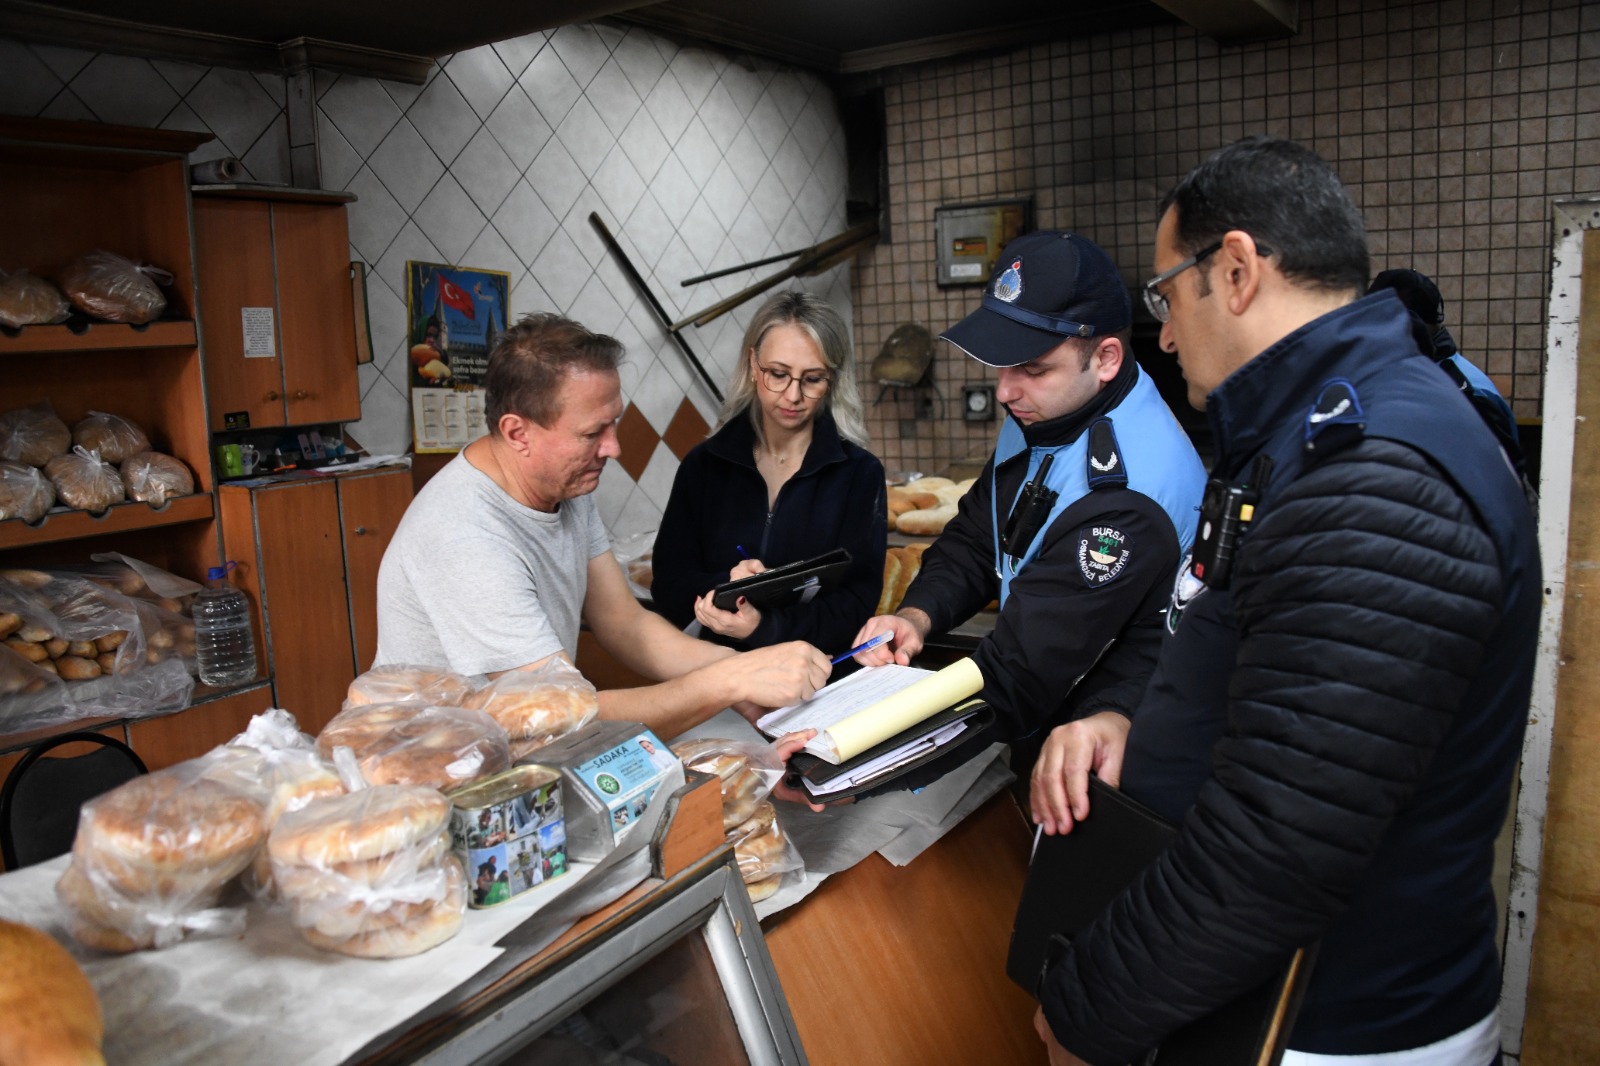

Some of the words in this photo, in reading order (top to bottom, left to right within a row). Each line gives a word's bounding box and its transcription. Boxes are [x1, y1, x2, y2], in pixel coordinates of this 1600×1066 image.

[452, 356, 475, 365] Ekmek
[453, 365, 469, 374] sofra
[1092, 527, 1125, 544] BURSA
[593, 746, 629, 769] SADAKA
